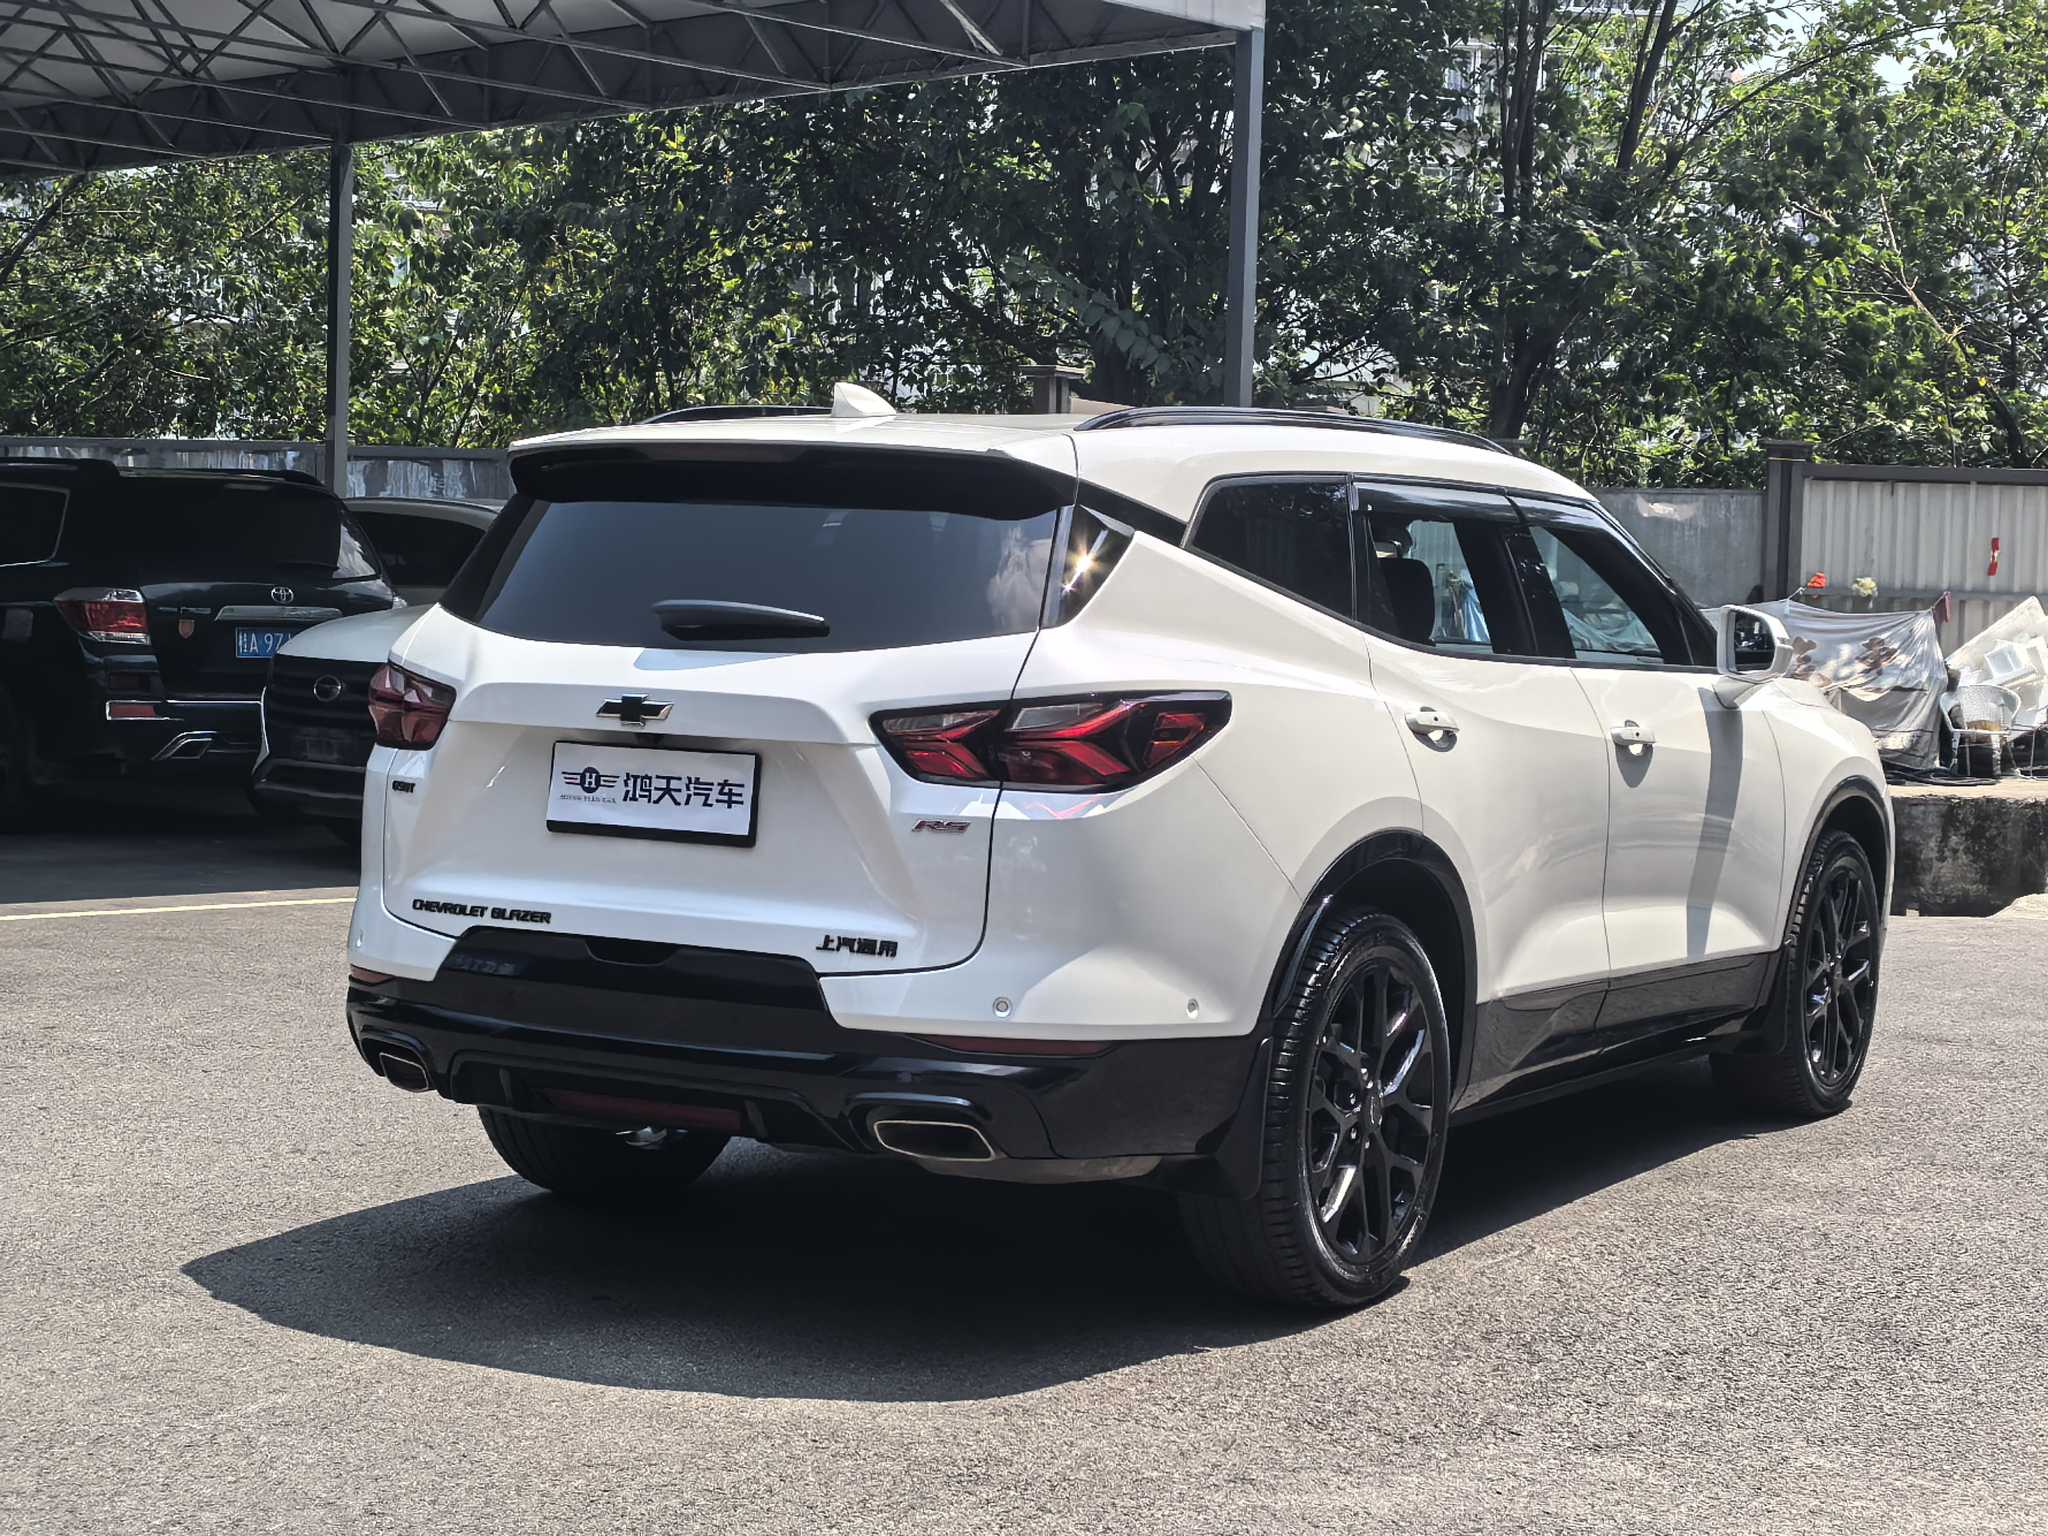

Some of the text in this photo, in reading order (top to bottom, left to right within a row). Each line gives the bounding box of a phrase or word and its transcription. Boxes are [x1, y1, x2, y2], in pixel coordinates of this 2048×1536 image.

[239, 632, 294, 654] 桂A97
[584, 772, 597, 788] H
[623, 772, 745, 809] 鸿天汽车
[911, 819, 971, 833] RS
[412, 898, 552, 925] CHEVROLET BLAZER
